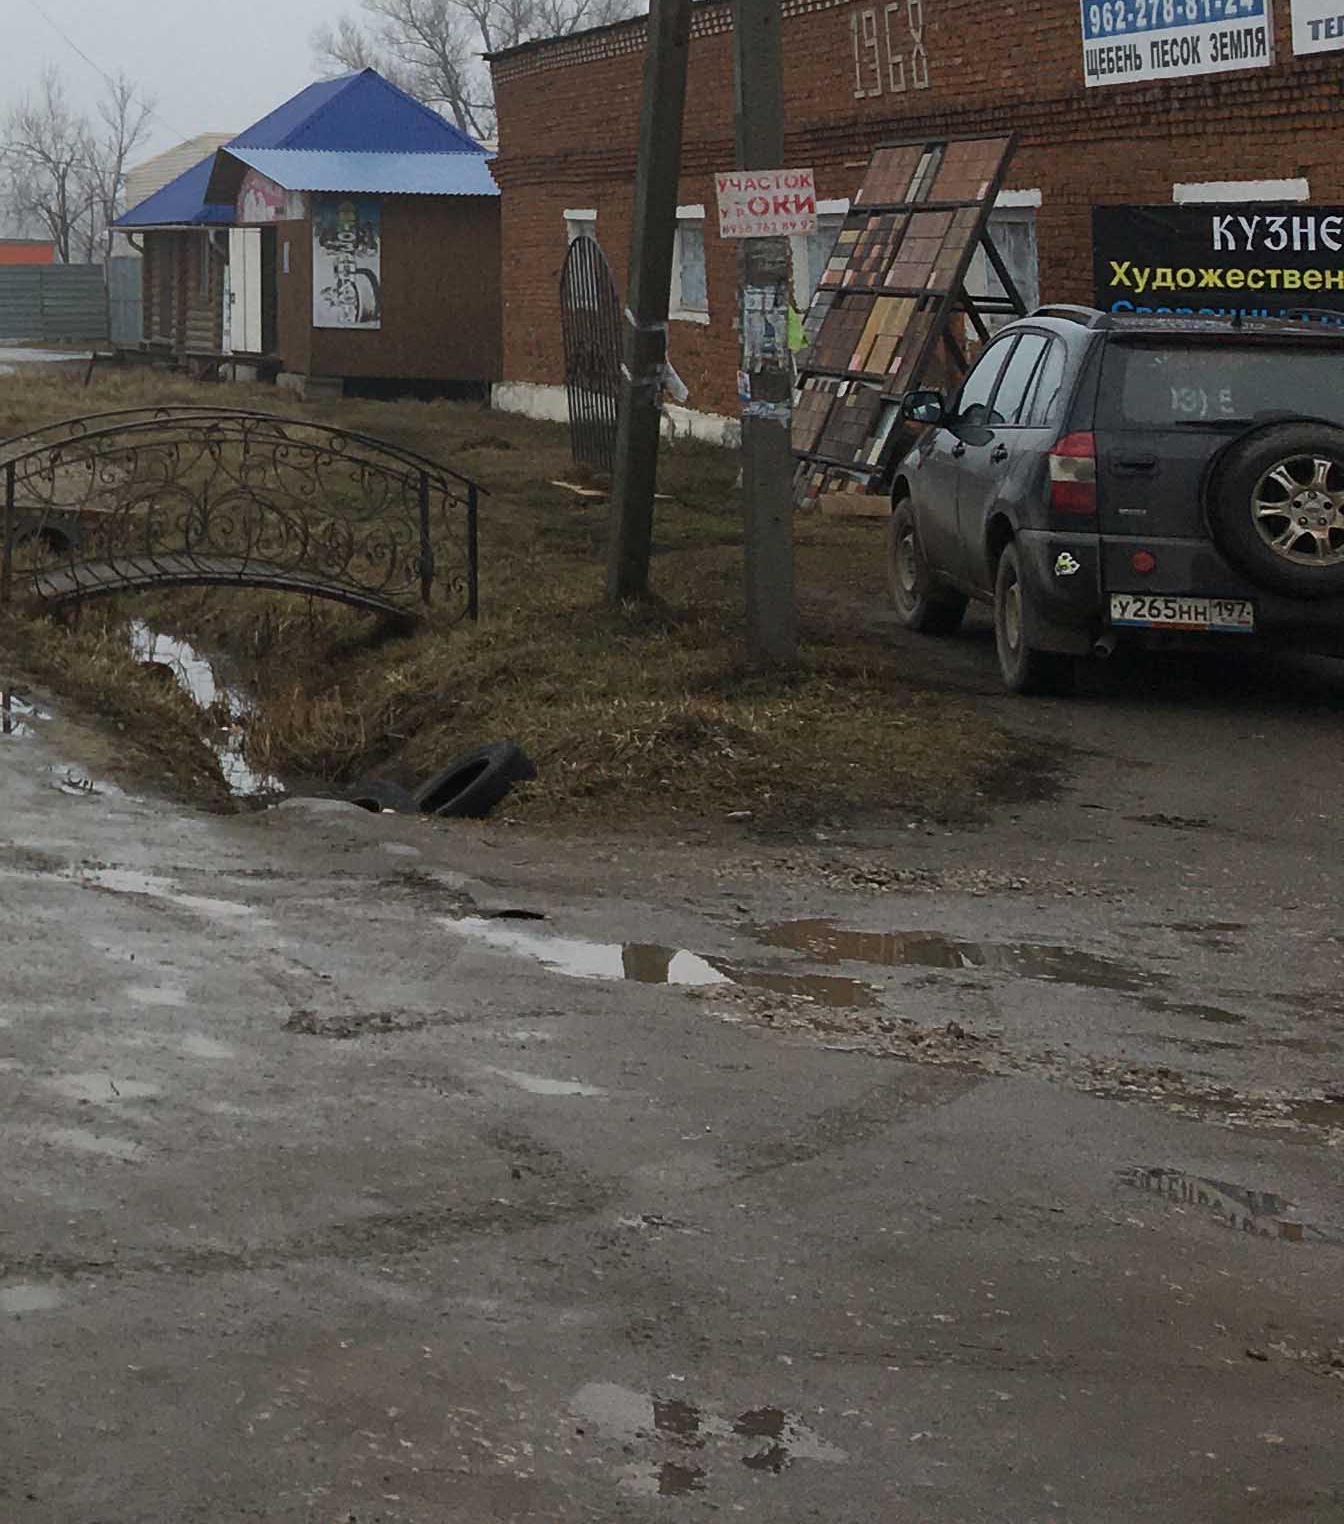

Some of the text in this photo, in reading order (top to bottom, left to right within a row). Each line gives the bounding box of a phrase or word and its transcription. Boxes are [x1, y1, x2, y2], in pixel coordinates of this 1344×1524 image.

[1086, 27, 1266, 80] ЩЕБЕНЬ ПЕСОК ЗЕМЛЯ
[719, 174, 812, 192] УЧАСТОК
[748, 194, 816, 217] ОКИ
[1212, 214, 1344, 252] КУЗНЕ
[1109, 261, 1344, 292] Художествен
[1214, 600, 1246, 618] 197
